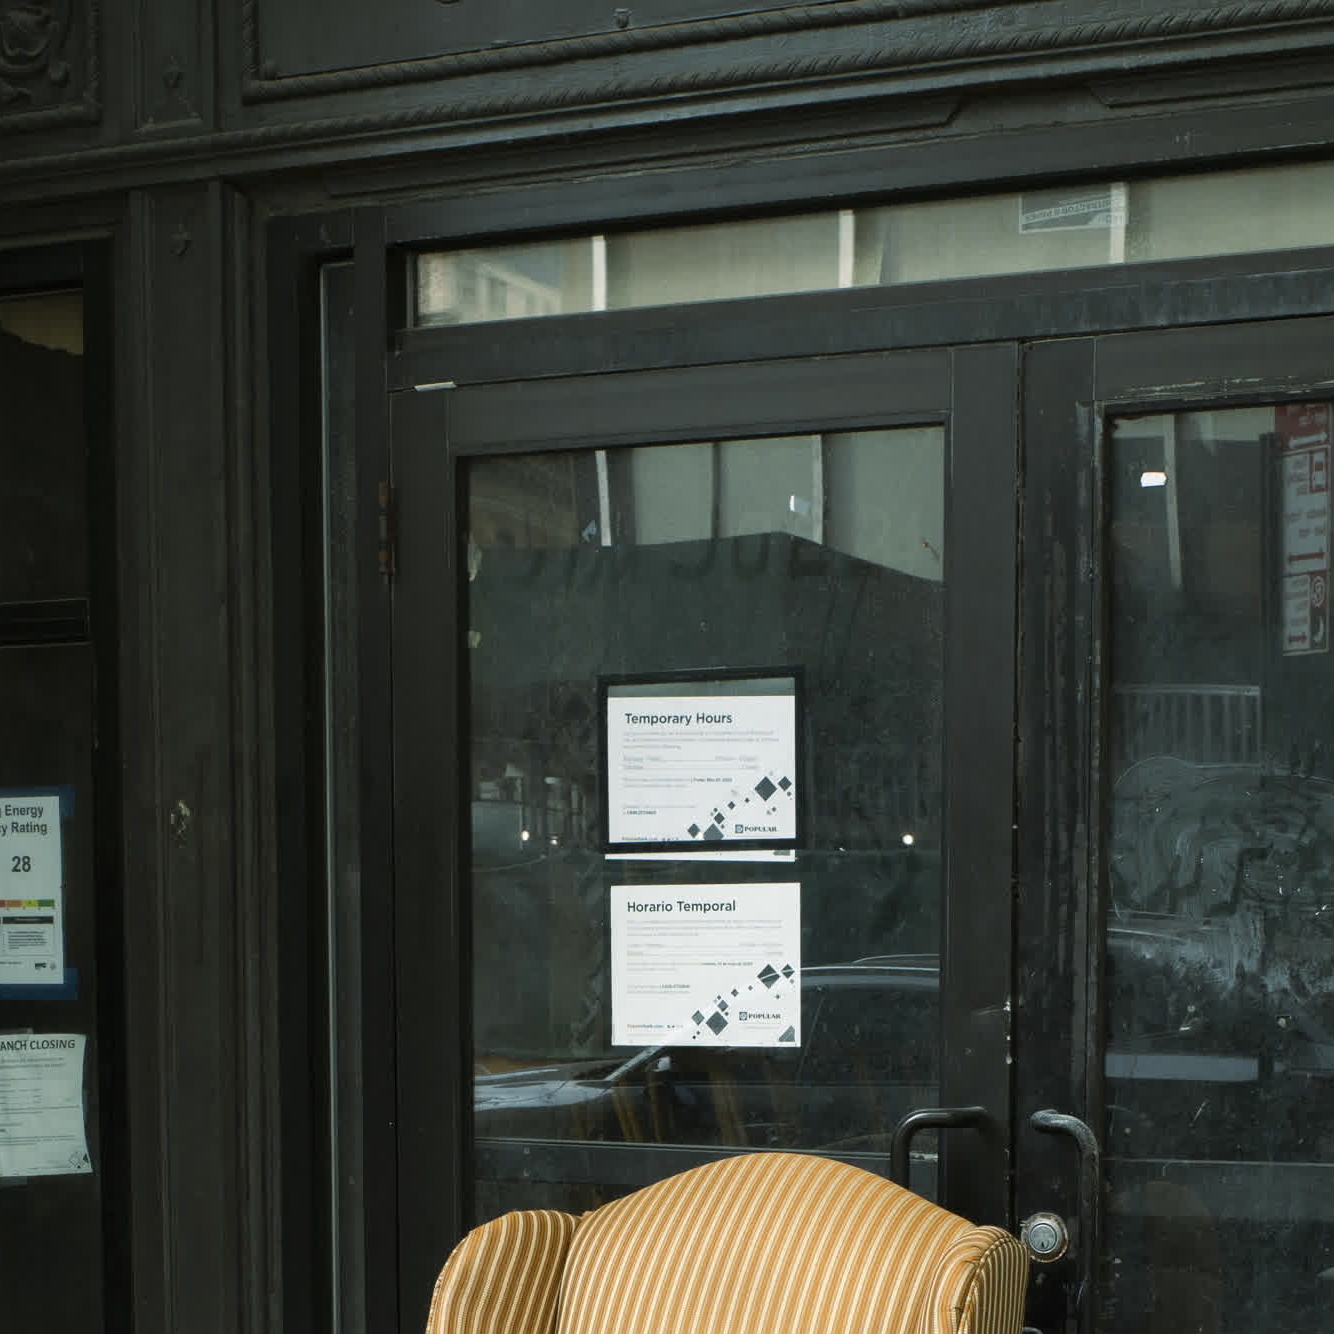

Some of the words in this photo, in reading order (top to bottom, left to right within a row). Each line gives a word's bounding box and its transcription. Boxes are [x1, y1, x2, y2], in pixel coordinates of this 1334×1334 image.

[625, 712, 692, 726] Temporary
[696, 712, 733, 724] Hours
[4, 804, 44, 819] Energy
[11, 822, 48, 836] Rating
[11, 856, 32, 873] 28
[627, 900, 673, 913] Horario
[676, 900, 736, 913] Temporal
[29, 1039, 76, 1050] CLOSING
